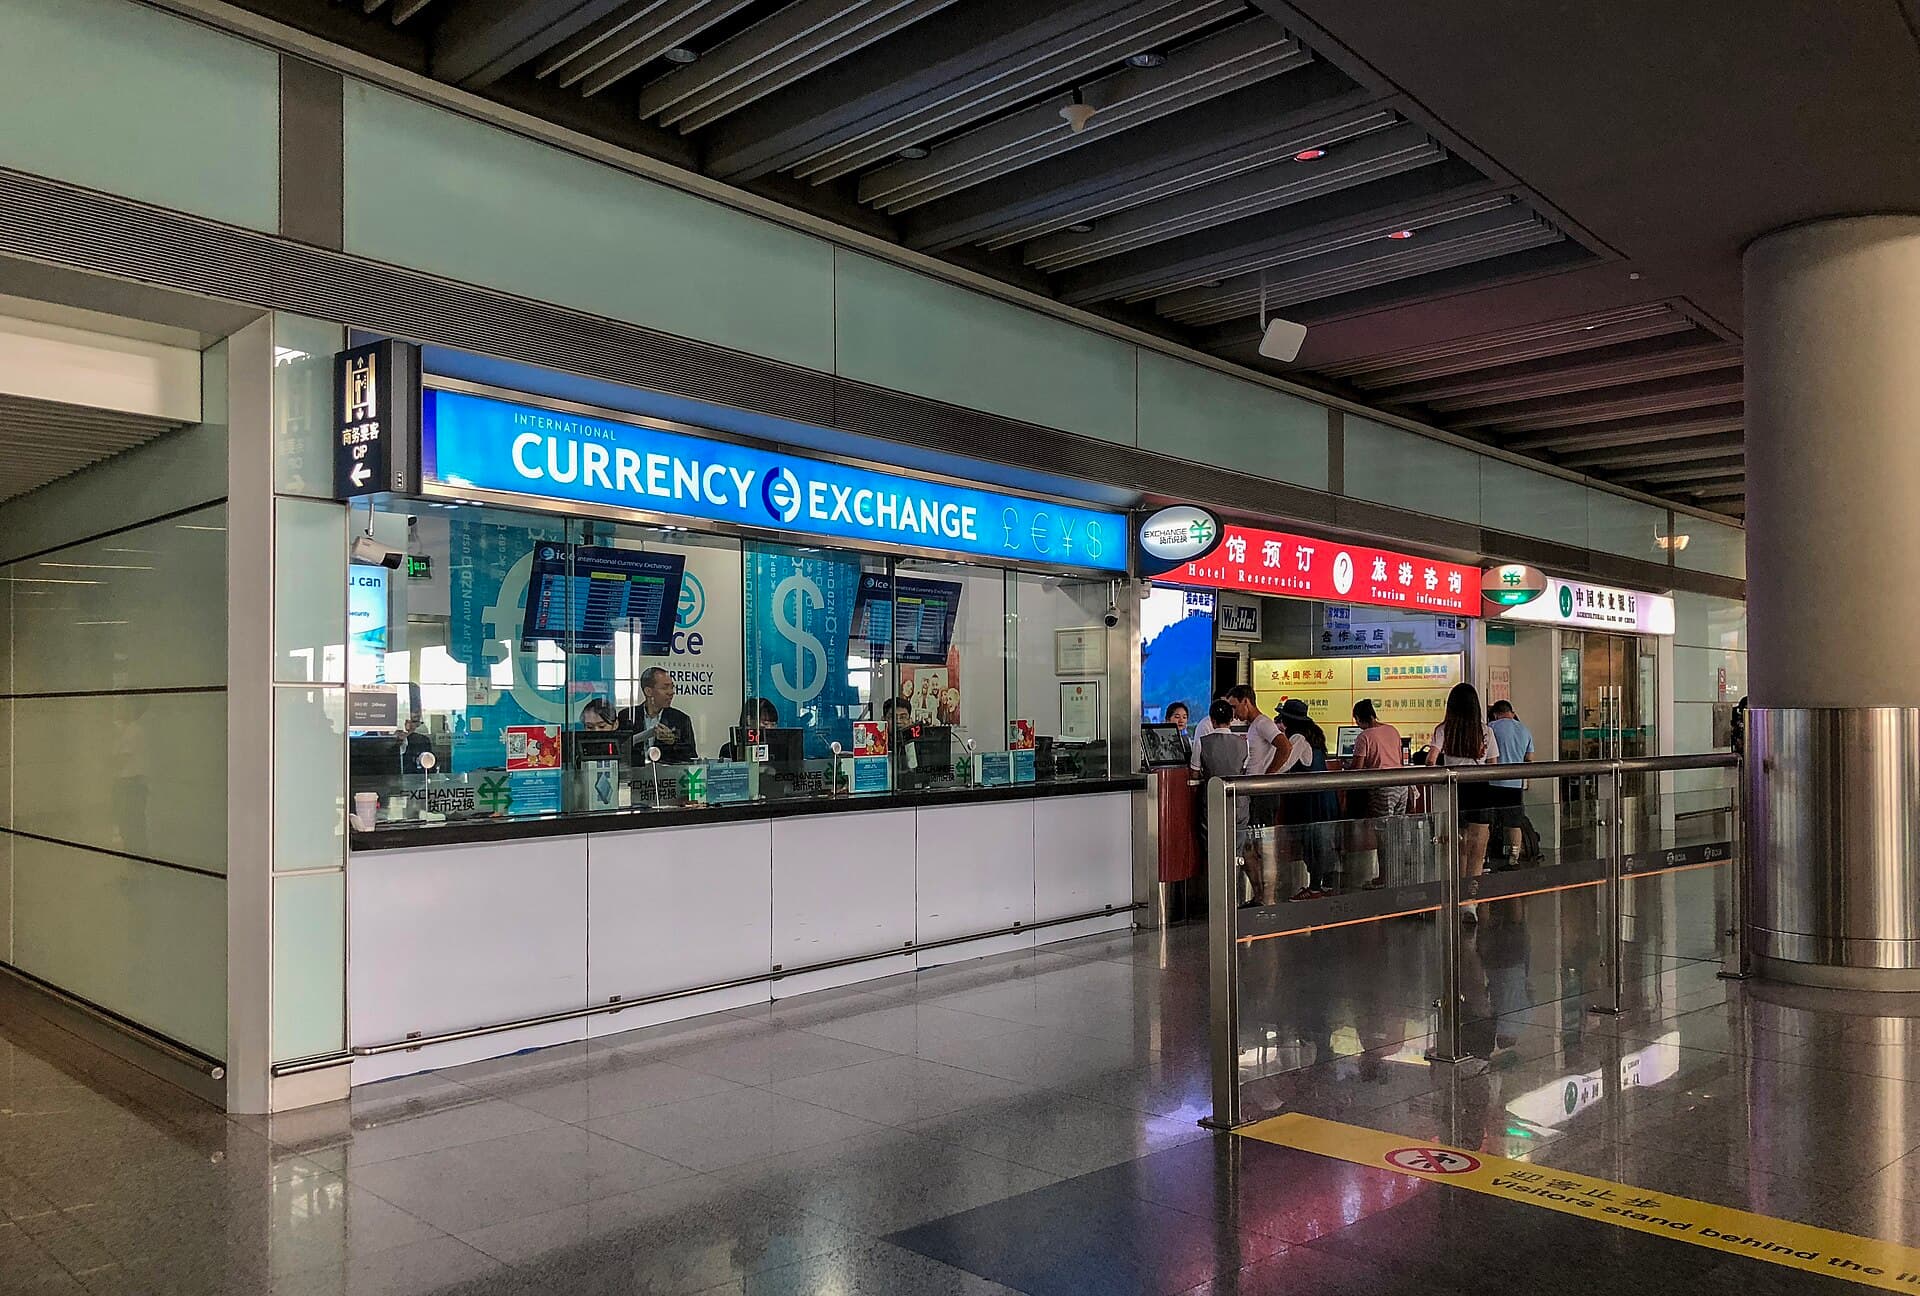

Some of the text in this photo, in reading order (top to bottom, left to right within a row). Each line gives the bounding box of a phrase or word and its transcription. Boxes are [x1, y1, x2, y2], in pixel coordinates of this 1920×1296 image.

[342, 422, 379, 446] 商务要客
[514, 413, 616, 441] INTERNATIONAL
[353, 445, 369, 459] CIP
[512, 432, 755, 508] CURRENCY
[809, 483, 977, 541] EXCHANGE
[1144, 528, 1187, 538] EXCHANGE
[1159, 535, 1188, 544] 货币兑换
[577, 556, 617, 566] International
[617, 559, 643, 569] Currency
[643, 561, 672, 571] Exchange
[1225, 534, 1462, 594] 馆预订 旅游咨询
[358, 577, 381, 587] can
[461, 570, 473, 600] NZD
[875, 579, 889, 589] ice
[1188, 563, 1311, 590] Hotel Reservation
[827, 591, 836, 614] NZD
[1371, 587, 1462, 608] Tourism information
[1576, 588, 1635, 613] 中国农业银行
[463, 601, 472, 620] AUD
[463, 624, 472, 640] JPY
[1321, 629, 1384, 642] 合作酒店
[672, 631, 704, 654] ce
[827, 648, 836, 673] EUR
[670, 671, 713, 682] RRENCY
[675, 685, 713, 695] HANGE
[1307, 698, 1328, 706] 場賓館
[428, 799, 475, 812] 货币兑换
[1504, 1170, 1661, 1209] 迎客止步
[1491, 1178, 1920, 1285] Visitors stand behind the li
